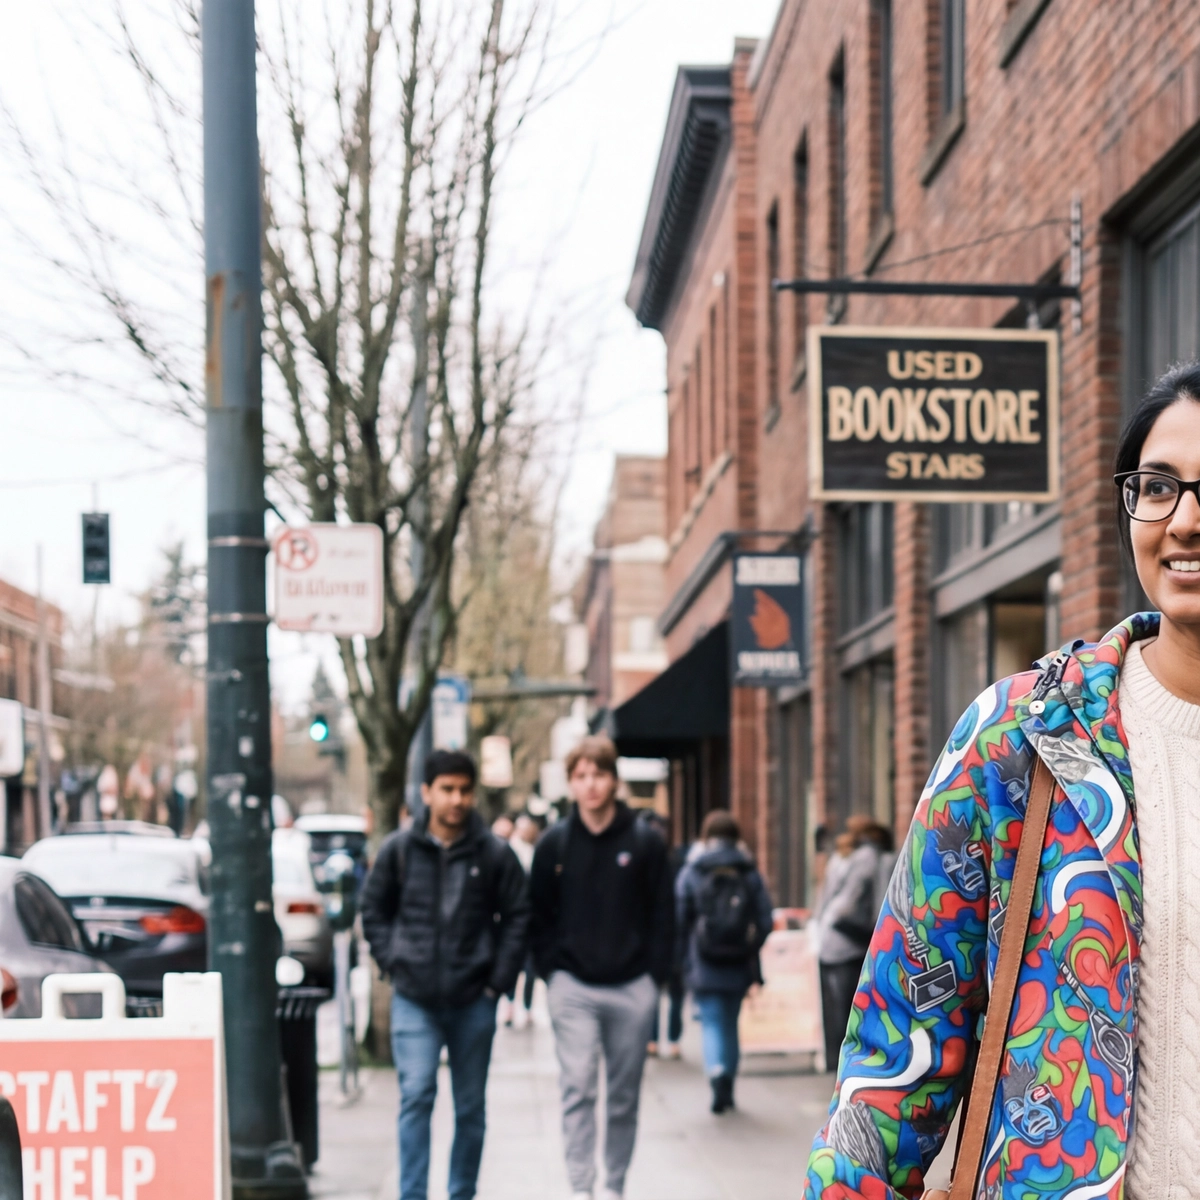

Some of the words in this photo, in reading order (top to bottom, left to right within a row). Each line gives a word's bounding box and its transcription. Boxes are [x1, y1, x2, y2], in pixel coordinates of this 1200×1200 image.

[887, 350, 983, 381] USED
[827, 386, 1041, 444] BOOKSTORE
[886, 451, 986, 480] STARS
